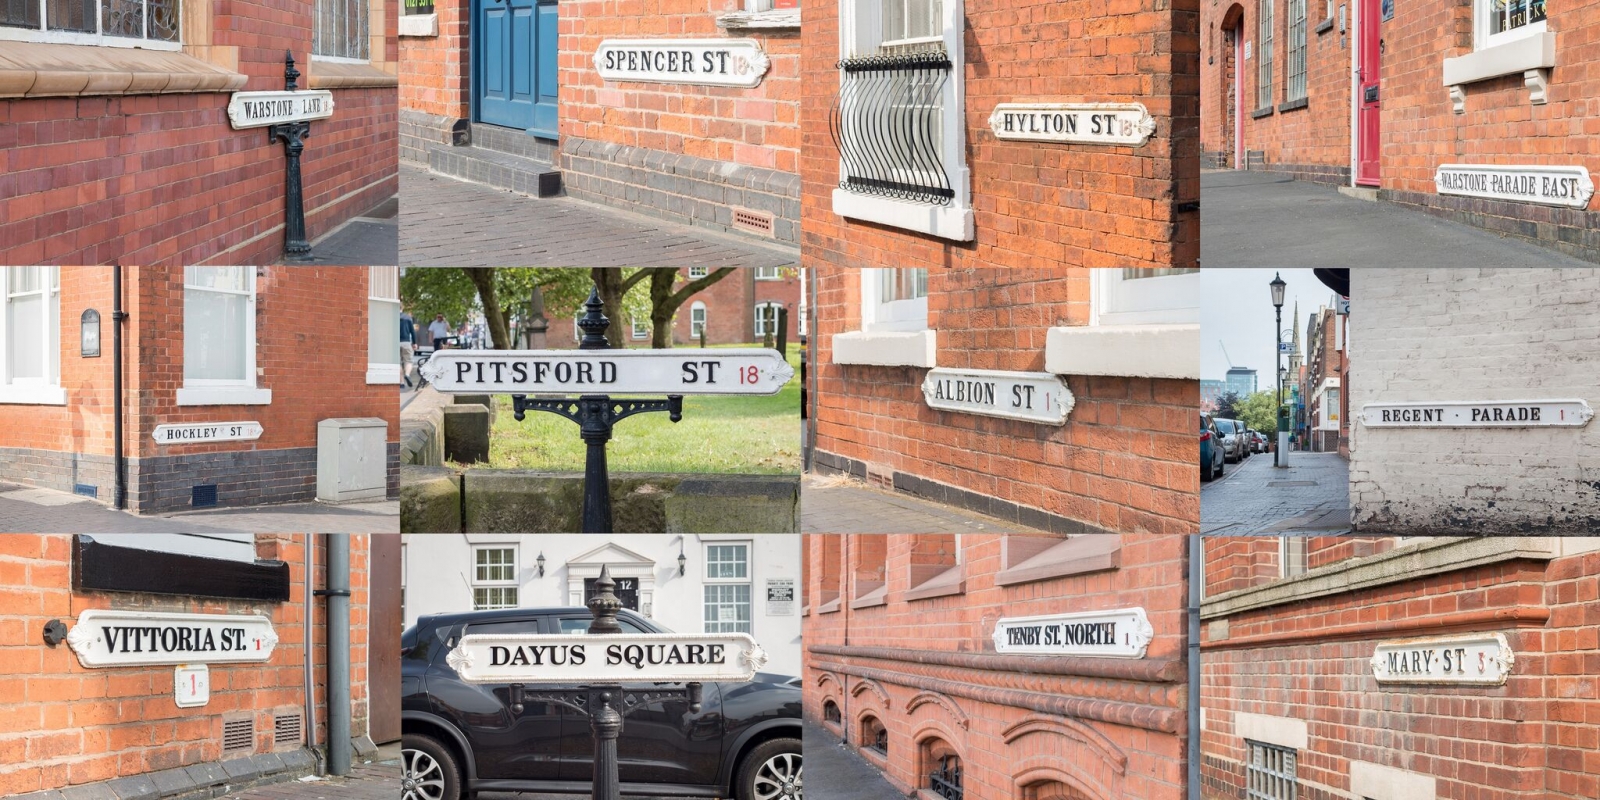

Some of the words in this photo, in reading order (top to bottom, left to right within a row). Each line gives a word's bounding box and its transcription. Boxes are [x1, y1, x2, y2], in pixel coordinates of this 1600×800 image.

[1502, 4, 1541, 32] PTRICK
[605, 50, 694, 73] SPENCER
[702, 51, 729, 74] ST
[244, 99, 293, 119] WARSTONE
[303, 98, 320, 114] LANE
[1003, 113, 1077, 134] HYLTON
[1091, 114, 1116, 136] ST
[1441, 172, 1487, 193] WARSTONE
[1491, 174, 1536, 196] PARADE
[1542, 176, 1578, 199] EAST
[455, 361, 618, 384] PITSFORD
[682, 361, 721, 384] ST
[739, 366, 759, 384] 18
[935, 379, 995, 405] ALBION
[1012, 384, 1035, 409] ST
[1382, 408, 1444, 422] REGENT
[1471, 407, 1541, 422] PARADE
[167, 427, 217, 440] HOCKLEY
[230, 426, 242, 437] ST
[102, 626, 216, 653] VITTORIA
[220, 628, 247, 651] ST.
[255, 639, 261, 651] 1
[1006, 626, 1042, 646] TENBY
[1065, 621, 1117, 646] NORTH
[489, 645, 586, 666] DAYUS
[606, 643, 726, 669] SQUARE
[1388, 649, 1433, 673] MARY
[1443, 648, 1465, 672] ST
